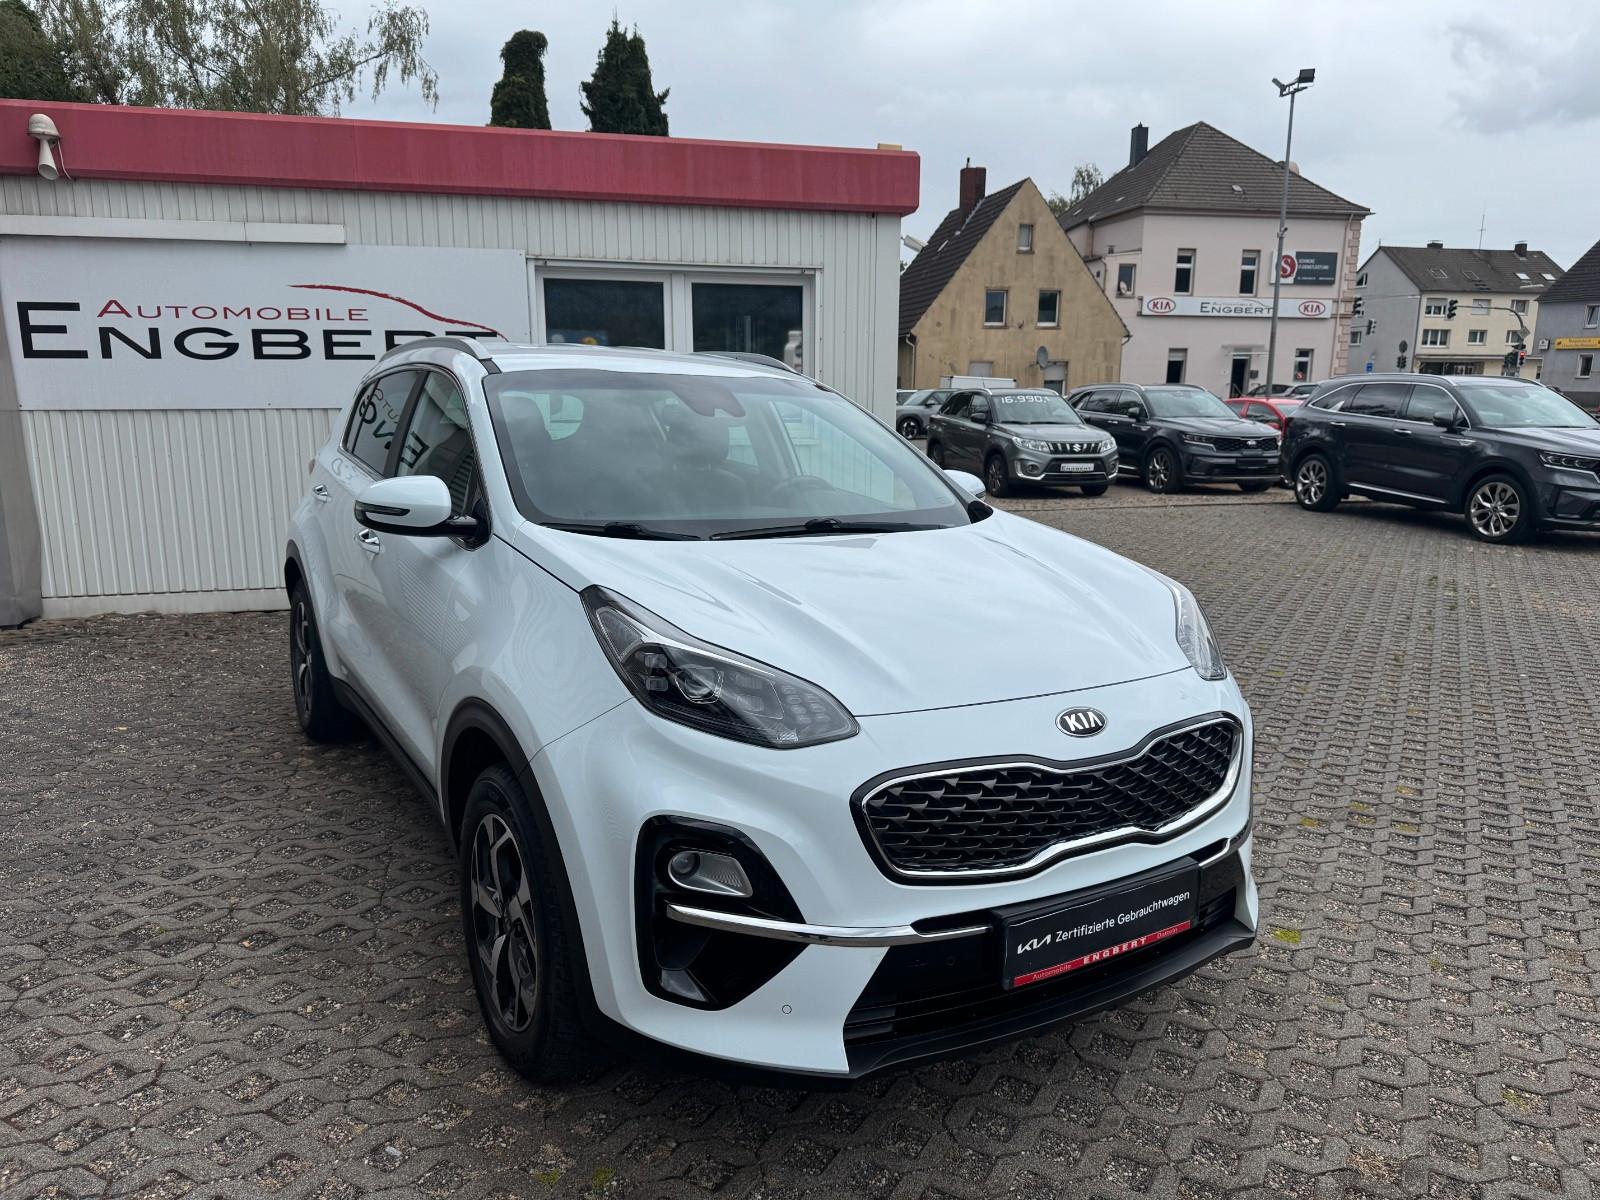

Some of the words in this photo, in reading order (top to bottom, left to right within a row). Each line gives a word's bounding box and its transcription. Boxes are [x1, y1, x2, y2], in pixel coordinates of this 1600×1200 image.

[96, 299, 369, 322] AUTOMOBILE
[1152, 301, 1171, 310] KIA
[1200, 301, 1274, 315] ENGBERT
[1303, 304, 1321, 314] KIA
[16, 301, 498, 361] ENGBE
[1063, 711, 1103, 732] KIA
[1017, 933, 1052, 955] KIA
[1055, 917, 1115, 943] Zertifizierte
[1117, 891, 1190, 925] Gebrauchtwagen
[1032, 963, 1072, 981] Automobile
[1083, 937, 1148, 965] ENGBERT
